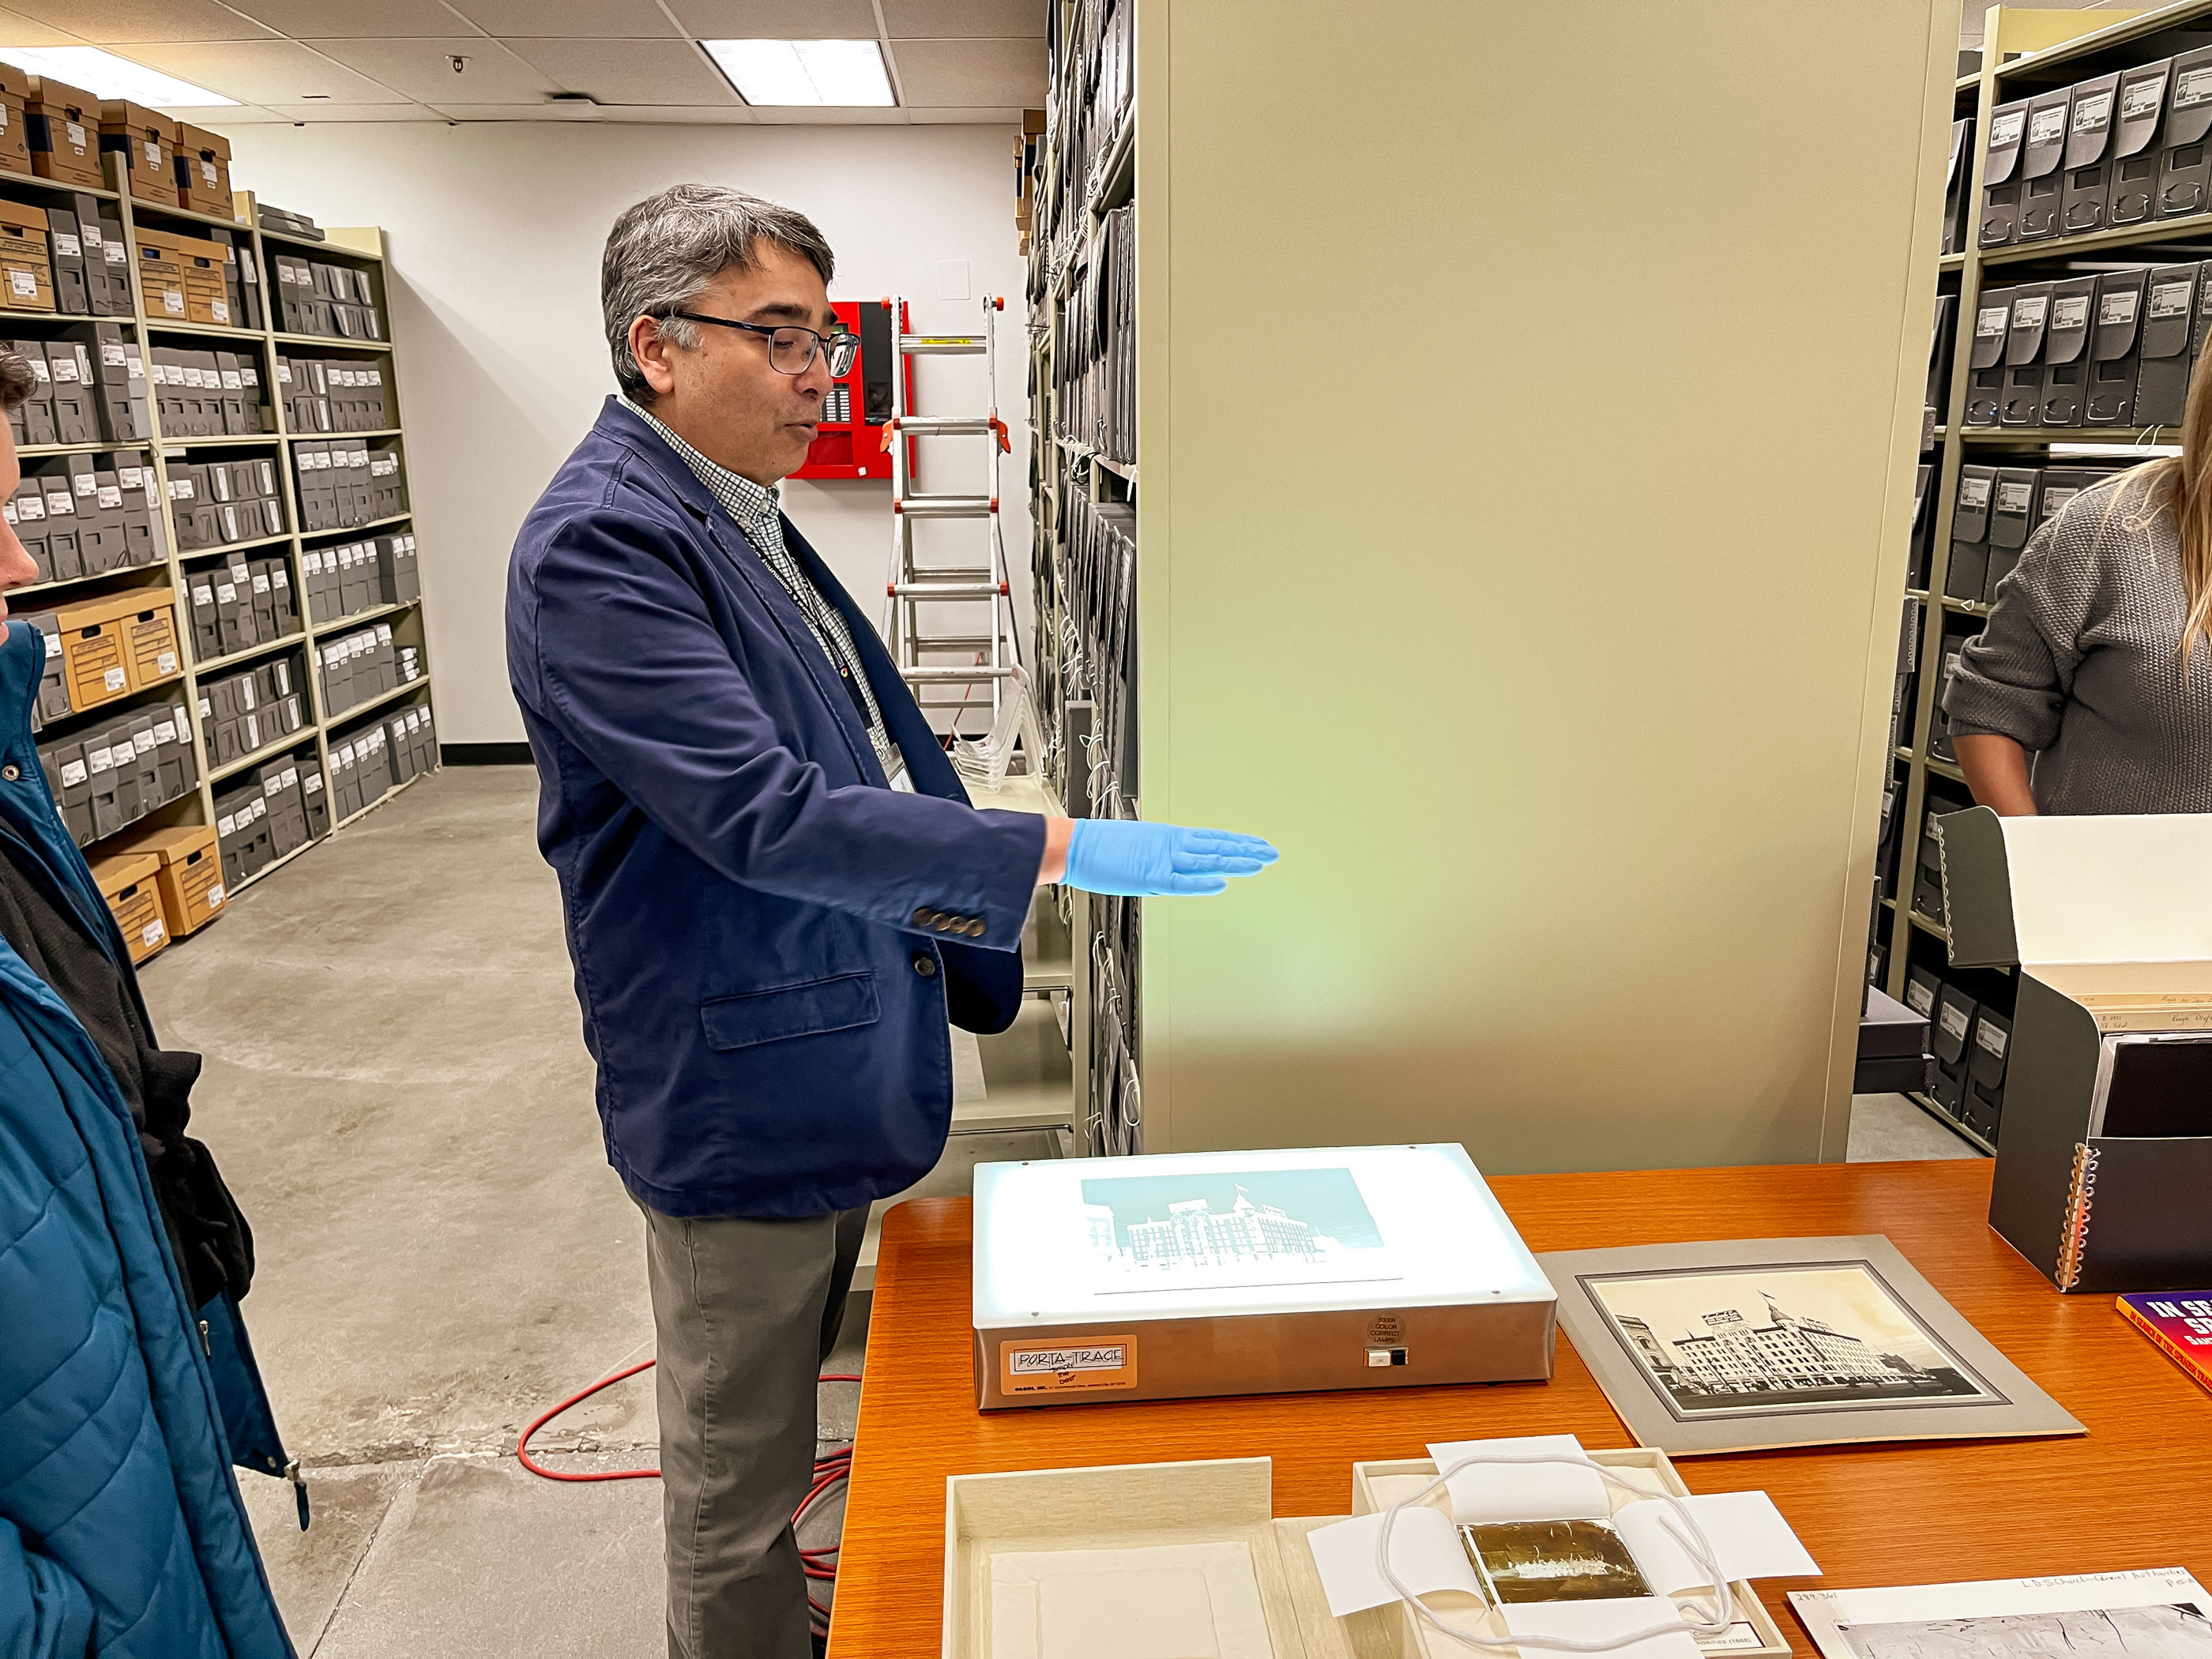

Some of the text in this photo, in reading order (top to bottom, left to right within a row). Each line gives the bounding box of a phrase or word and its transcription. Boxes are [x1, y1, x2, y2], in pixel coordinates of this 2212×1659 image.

[2146, 1300, 2212, 1318] IN SE
[1019, 1349, 1123, 1366] PORTA-TRACE
